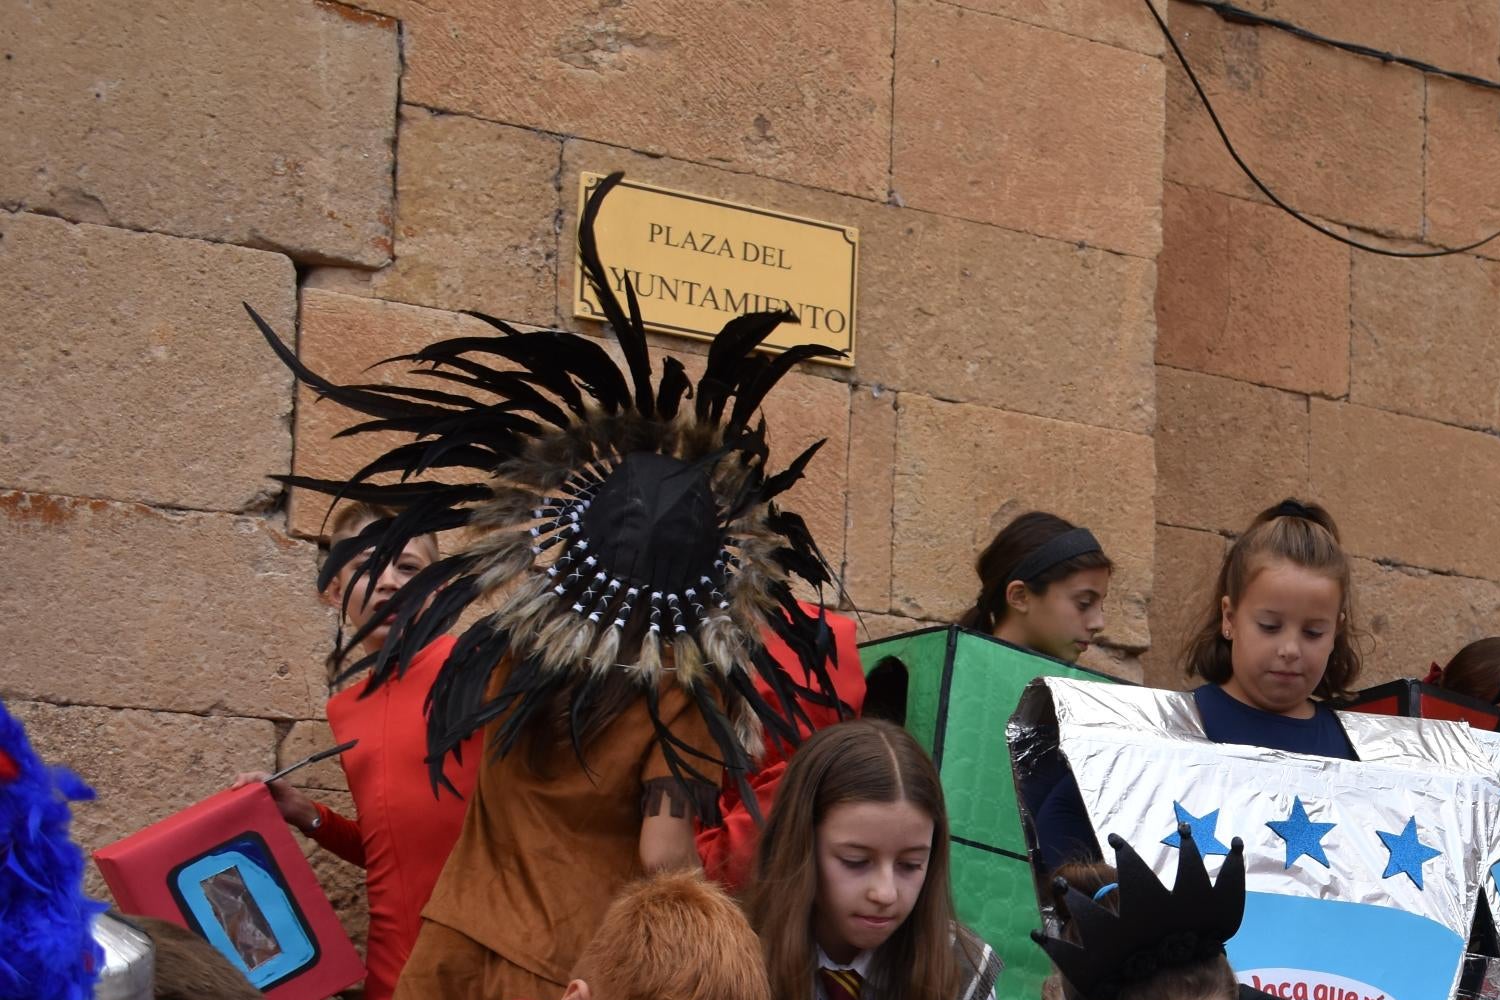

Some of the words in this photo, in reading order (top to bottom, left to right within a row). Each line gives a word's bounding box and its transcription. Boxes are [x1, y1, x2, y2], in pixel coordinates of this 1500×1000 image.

[648, 222, 735, 258] PLAZA
[742, 241, 792, 270] DEL
[608, 266, 846, 333] YUNTAMIENTO
